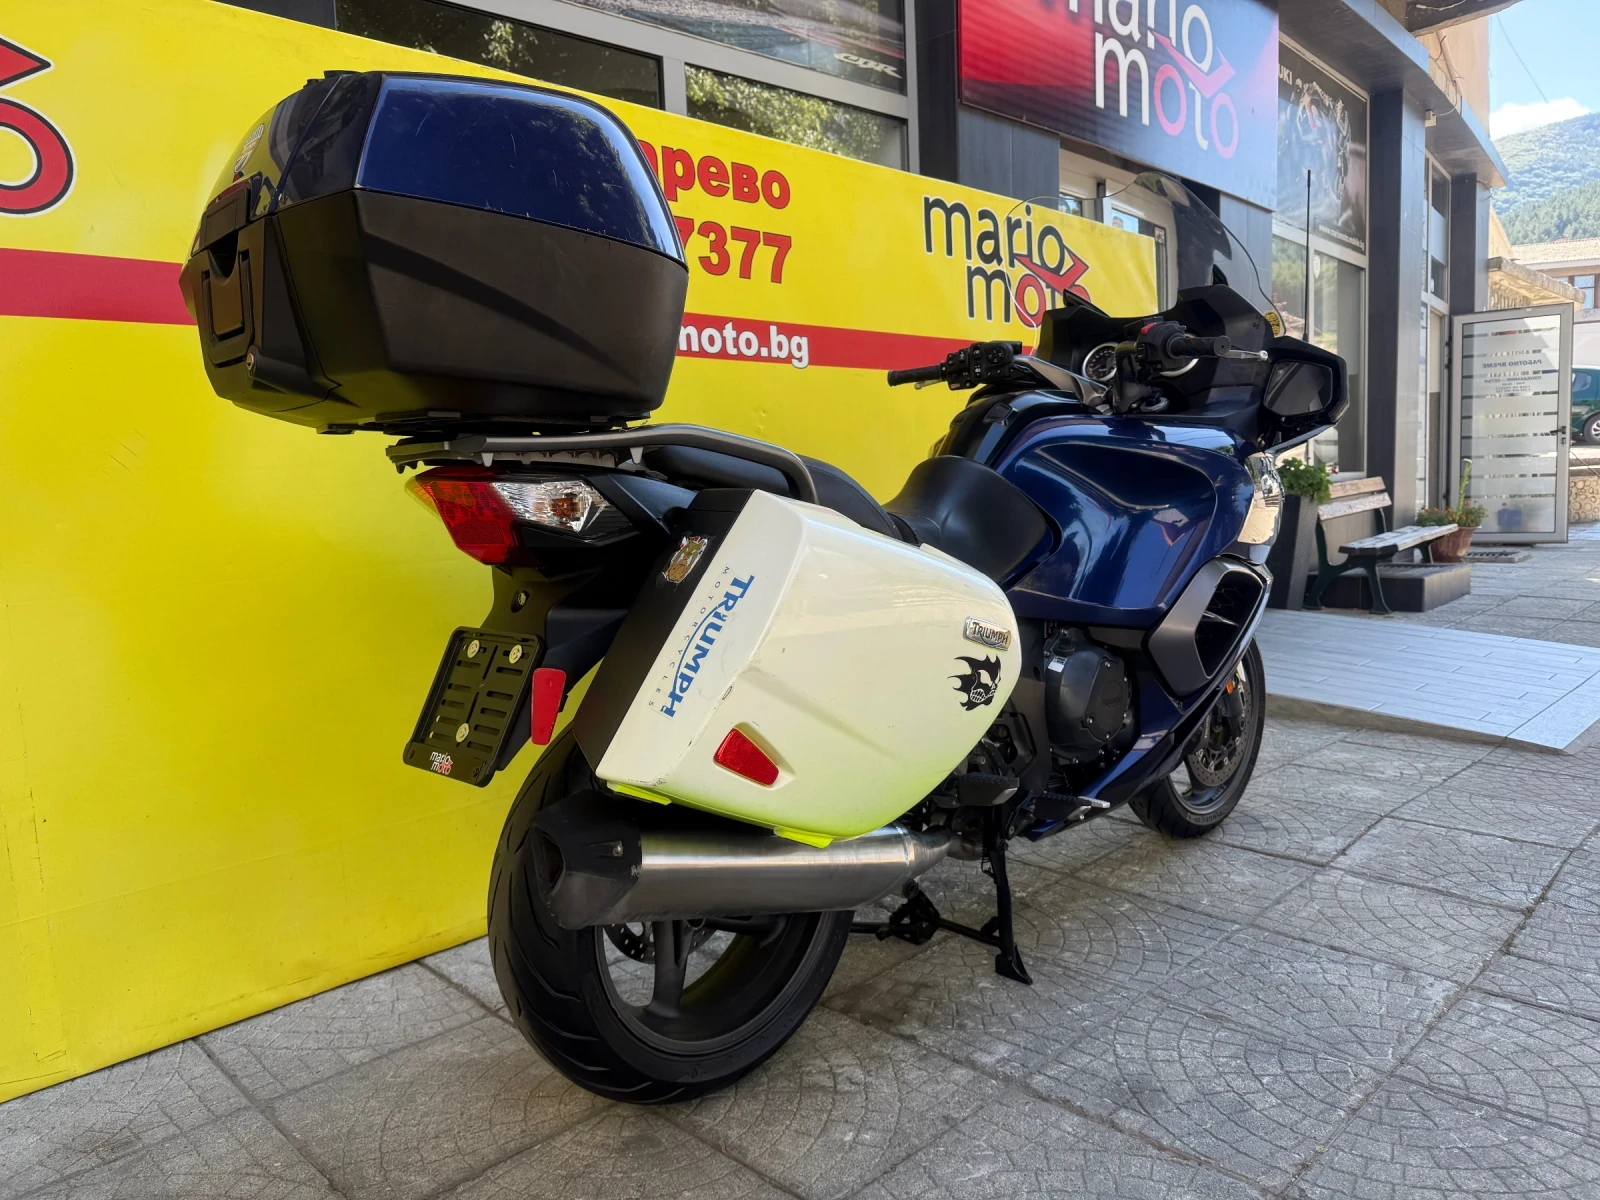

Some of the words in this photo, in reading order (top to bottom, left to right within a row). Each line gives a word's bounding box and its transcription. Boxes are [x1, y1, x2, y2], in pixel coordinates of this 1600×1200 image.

[1095, 32, 1239, 159] moto
[923, 196, 1066, 275] mario
[966, 264, 1091, 328] mot
[648, 566, 730, 706] MOTORCYCLES
[660, 574, 755, 718] TRIUMPH
[972, 621, 1009, 646] TRIUMPH
[430, 752, 453, 764] mario
[431, 762, 452, 775] moto
